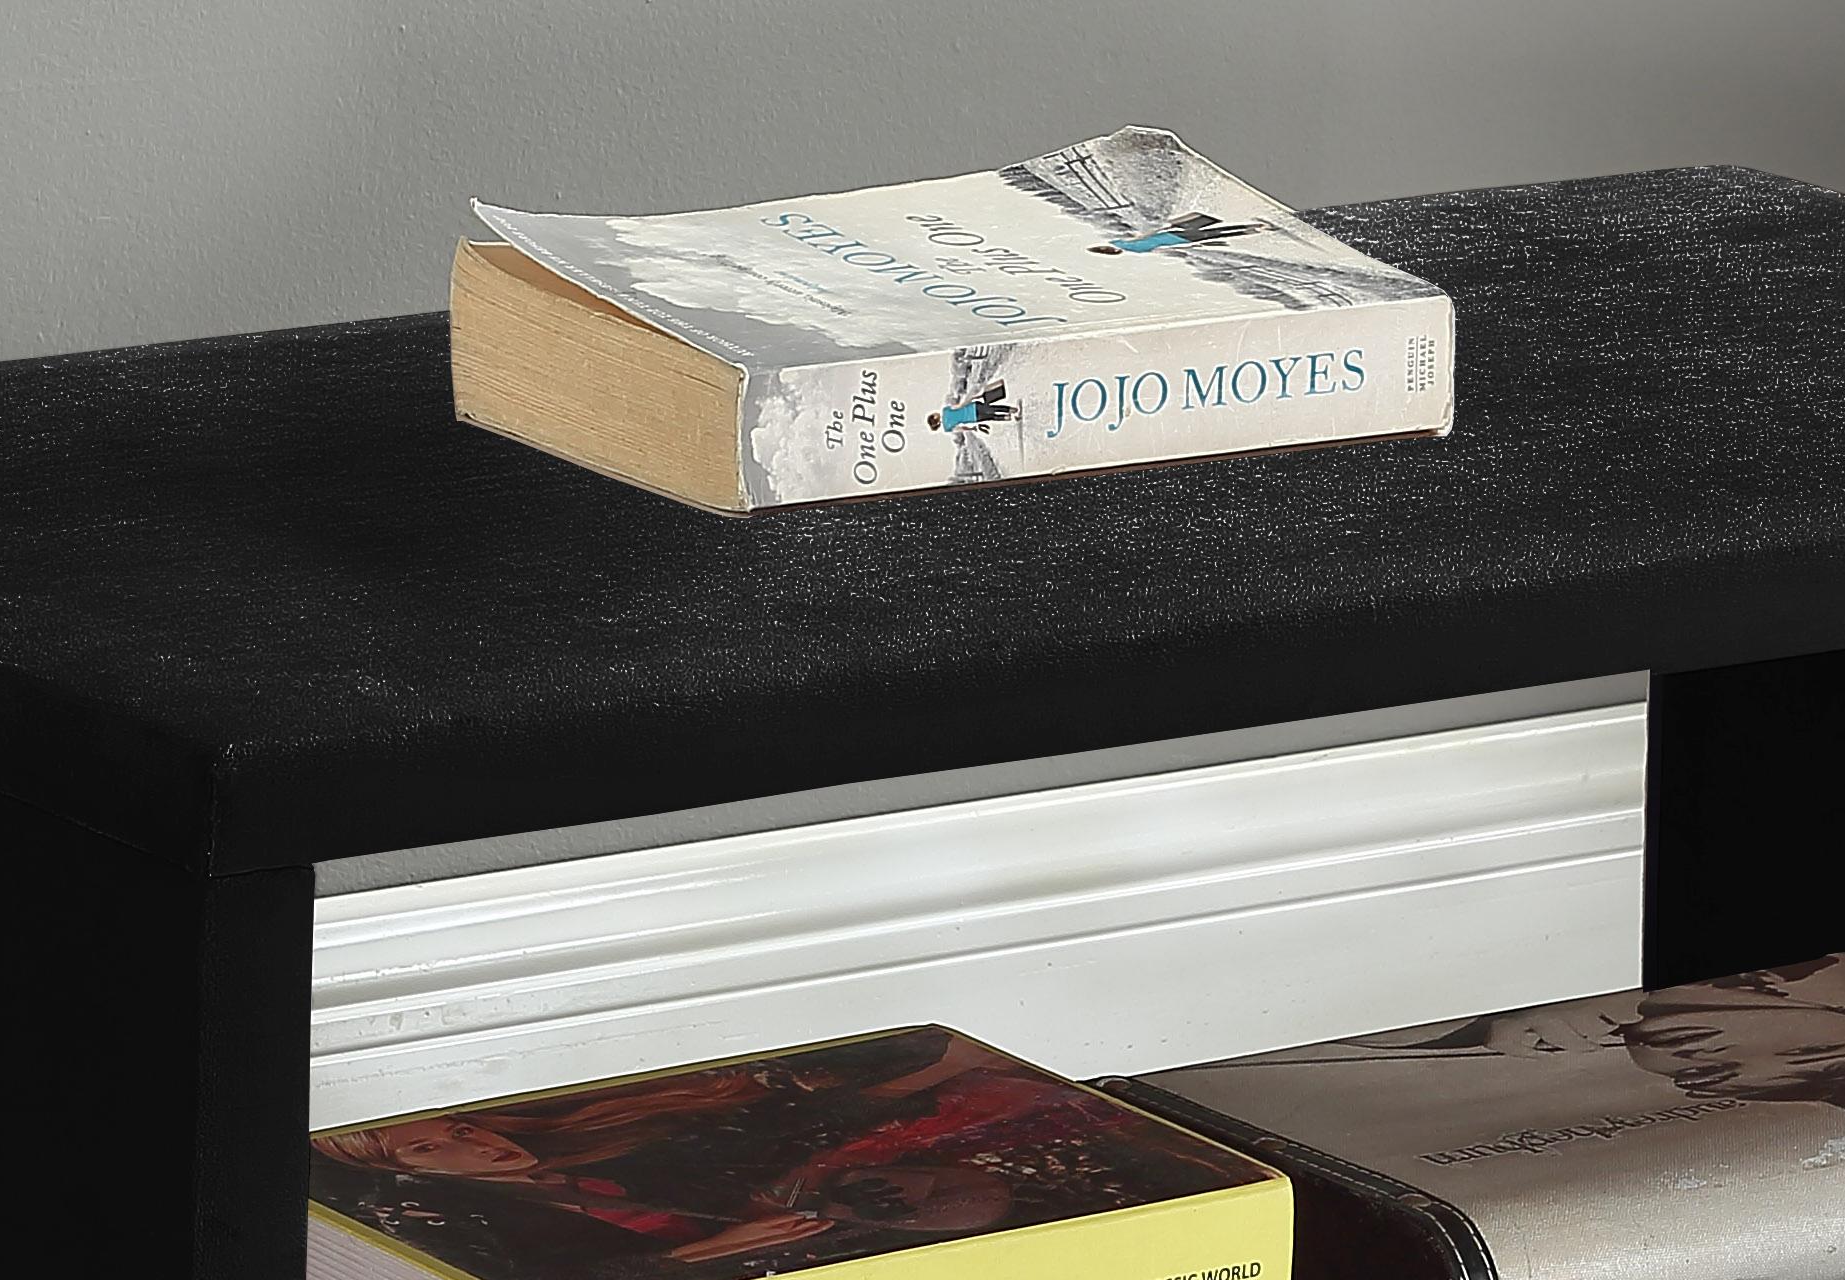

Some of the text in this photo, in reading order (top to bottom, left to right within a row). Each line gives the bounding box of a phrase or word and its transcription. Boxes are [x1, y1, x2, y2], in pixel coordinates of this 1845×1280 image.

[762, 212, 943, 284] MOYES
[906, 213, 1126, 304] One Plus One
[923, 283, 1066, 327] JOJO
[1407, 337, 1415, 392] PENGUIN
[1419, 334, 1427, 392] MICHAEL
[1427, 339, 1435, 386] JOSEPH
[1047, 349, 1366, 437] JOJO MOYES
[825, 410, 844, 449] The
[852, 370, 877, 485] One Plus
[881, 400, 905, 453] One
